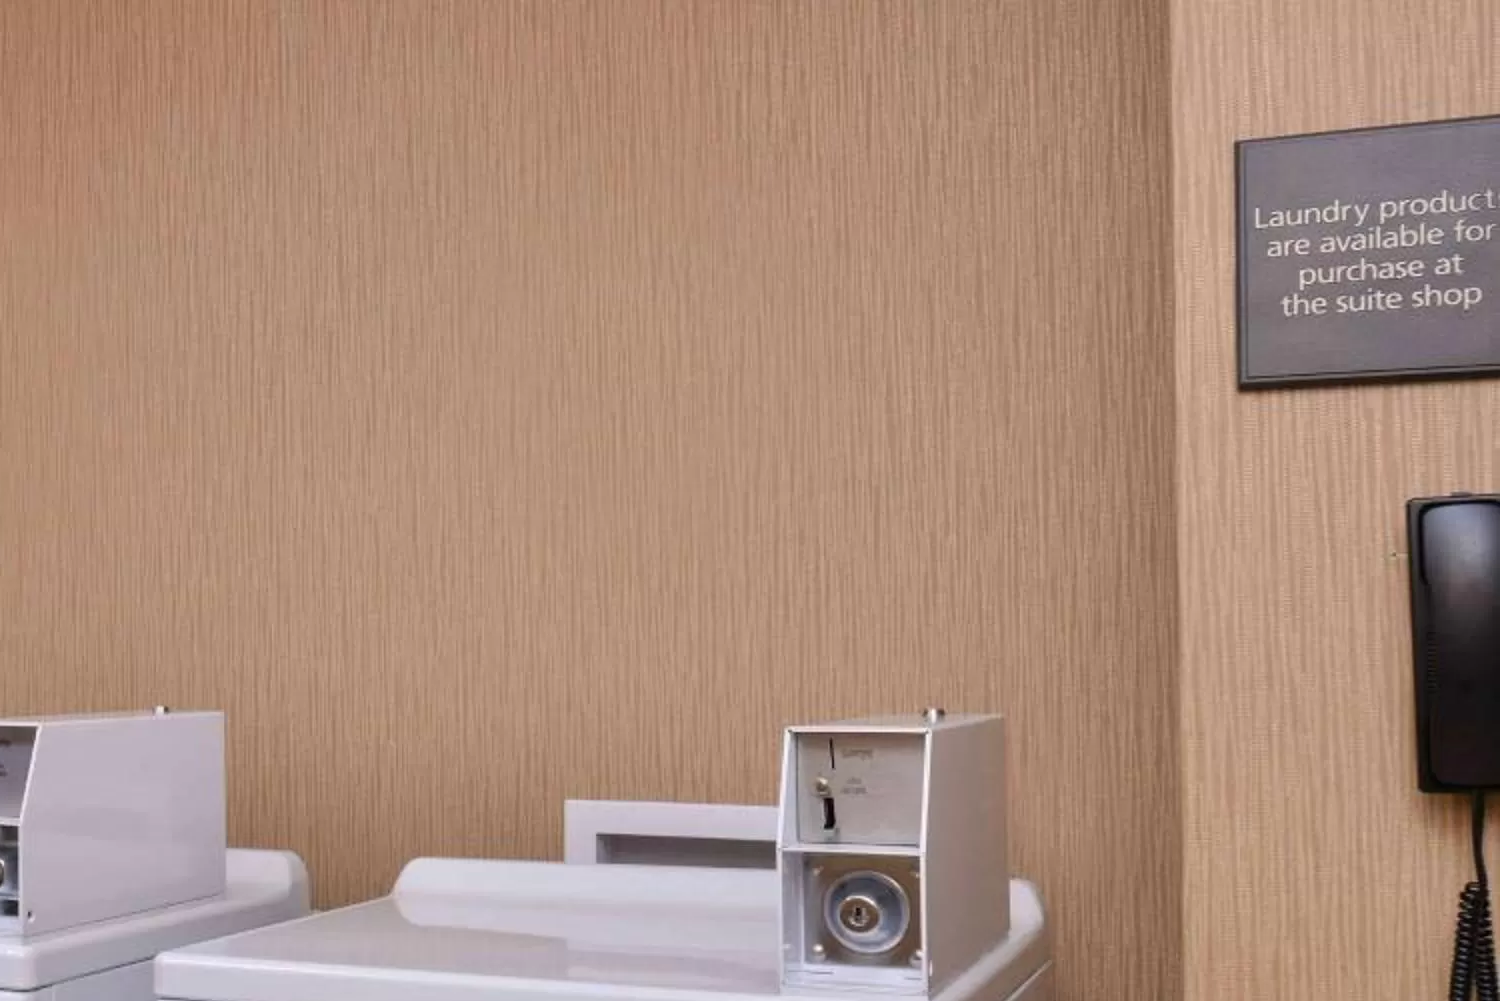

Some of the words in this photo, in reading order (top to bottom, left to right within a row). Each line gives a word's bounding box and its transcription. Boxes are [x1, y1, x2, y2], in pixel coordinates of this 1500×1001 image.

[1254, 199, 1370, 229] Laundry
[1379, 188, 1500, 224] product
[1266, 237, 1311, 258] are
[1320, 223, 1445, 253] available
[1453, 219, 1497, 243] for
[1299, 257, 1425, 290] purchase
[1434, 253, 1465, 277] at
[1281, 293, 1328, 317] the
[1336, 287, 1402, 313] suite
[1411, 283, 1483, 310] shop
